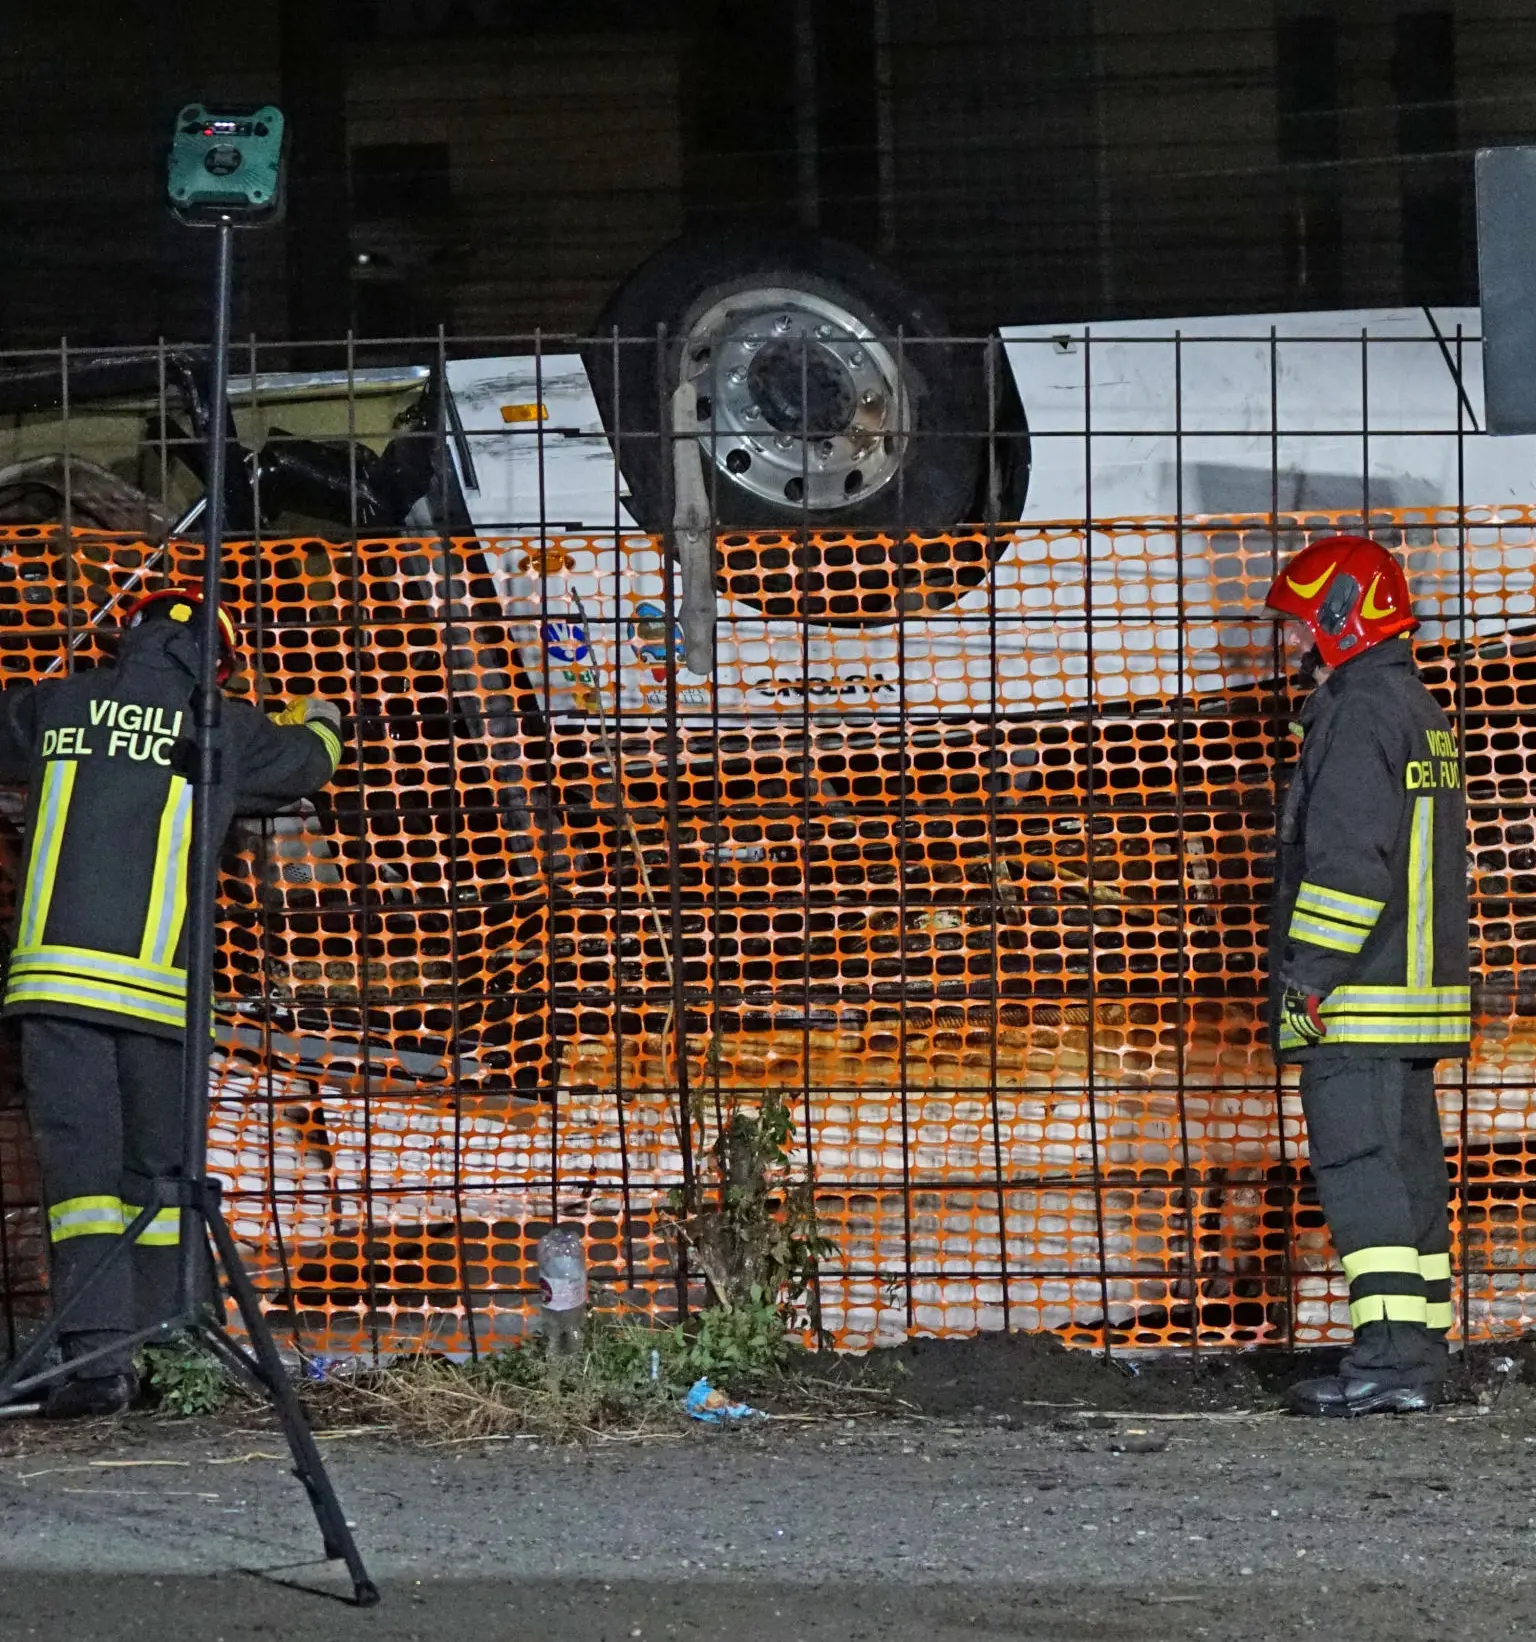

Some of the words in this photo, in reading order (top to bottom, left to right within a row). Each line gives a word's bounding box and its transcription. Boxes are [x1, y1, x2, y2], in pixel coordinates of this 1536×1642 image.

[89, 700, 183, 737] VIGILI
[42, 727, 93, 757] DEL
[1406, 761, 1437, 789] DEL
